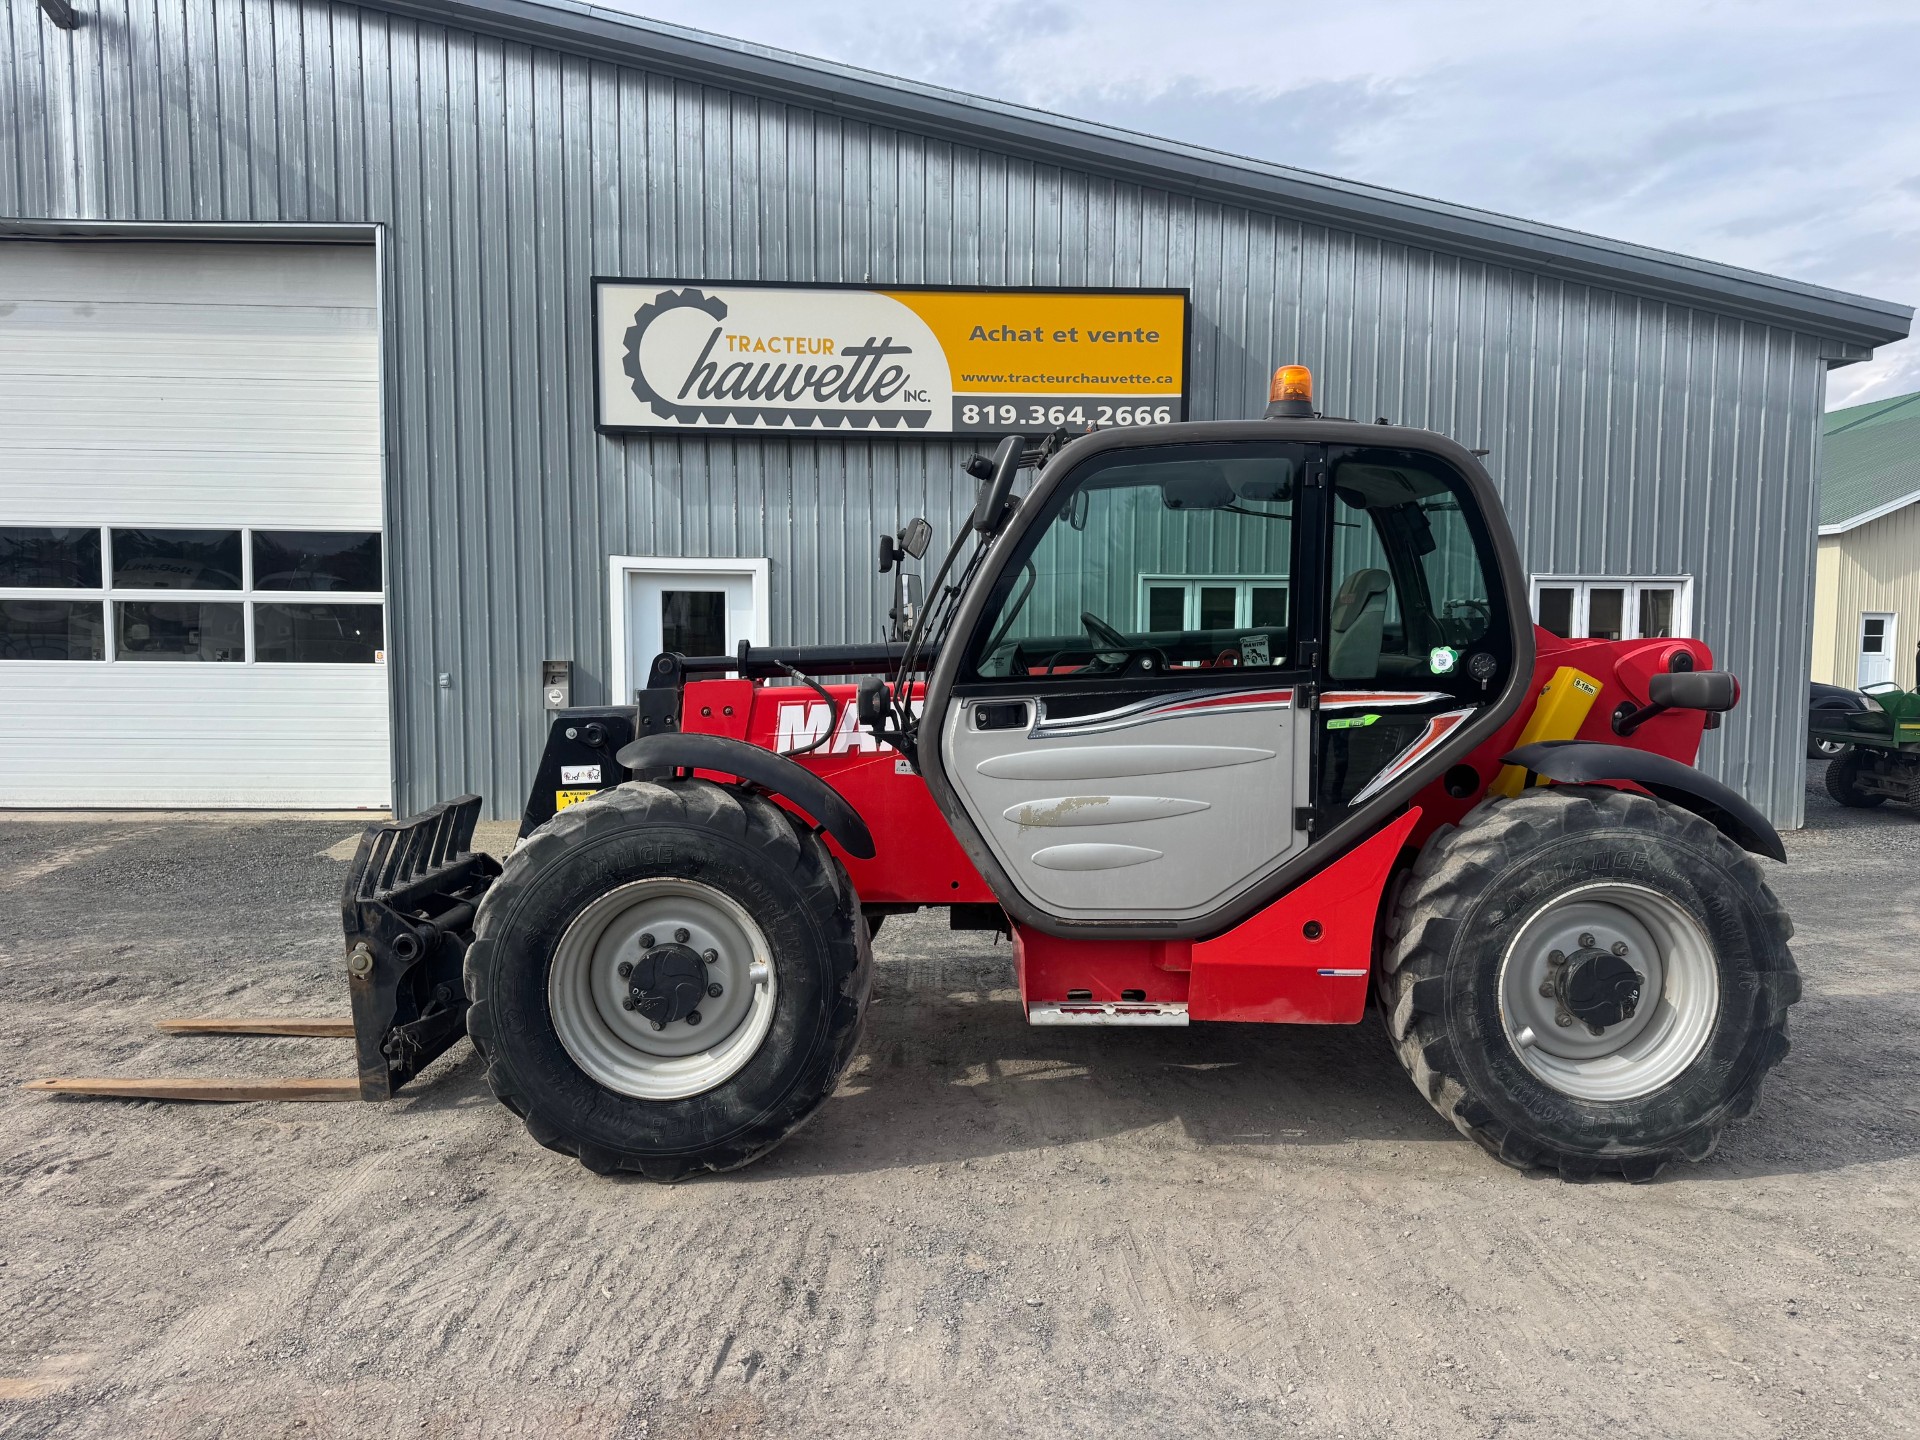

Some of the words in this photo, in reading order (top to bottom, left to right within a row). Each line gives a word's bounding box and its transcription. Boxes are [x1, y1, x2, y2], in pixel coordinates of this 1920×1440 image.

[968, 325, 1044, 342] Achat
[1052, 327, 1079, 343] et
[1087, 328, 1160, 343] vente
[622, 287, 913, 405] Chauvette
[903, 389, 931, 403] INC.
[725, 335, 835, 355] TRACTEUR
[961, 373, 1174, 385] www.tracteurchauvette.ca
[961, 404, 1172, 426] 819.364.2666
[632, 987, 648, 998] OK
